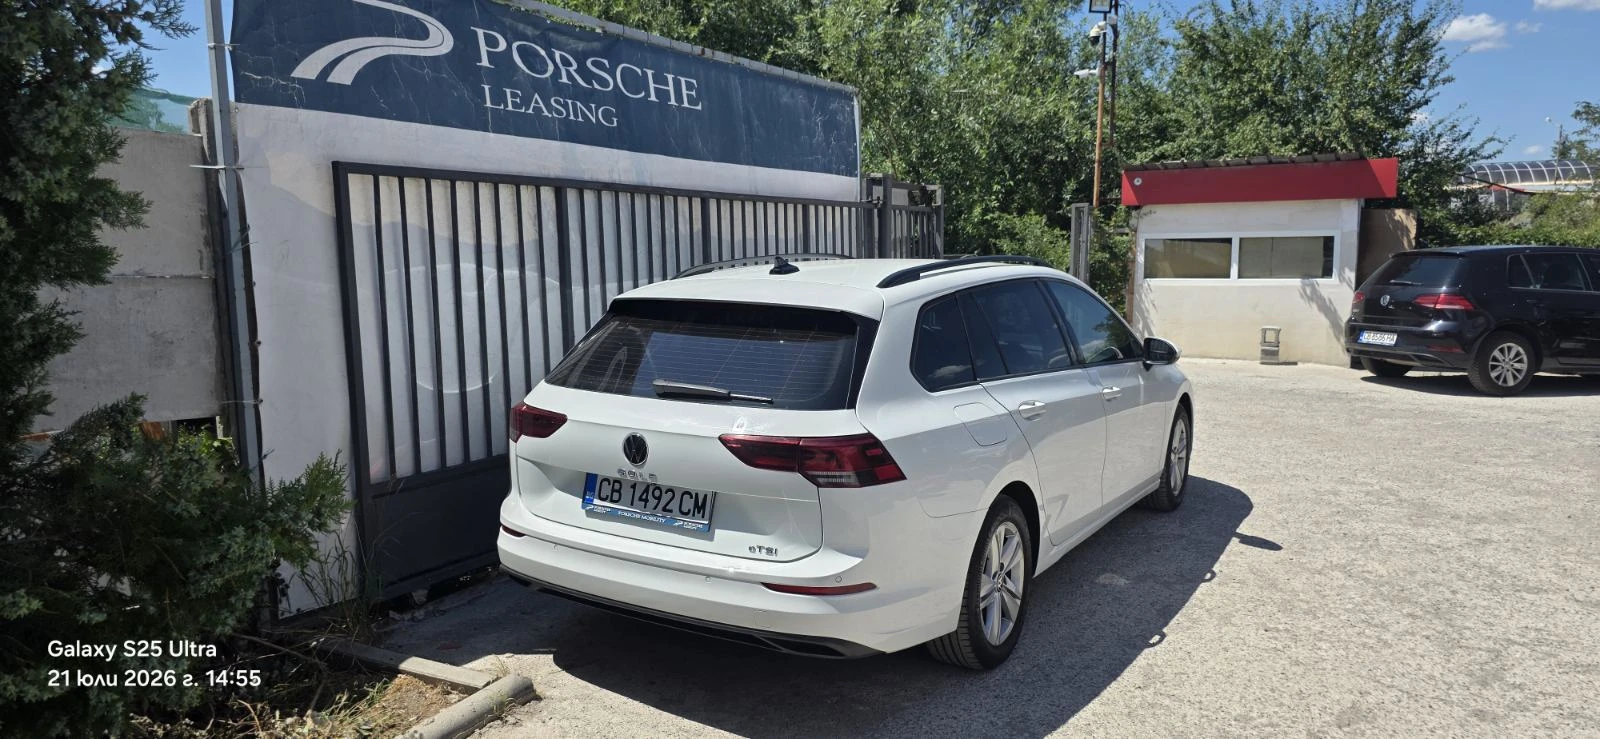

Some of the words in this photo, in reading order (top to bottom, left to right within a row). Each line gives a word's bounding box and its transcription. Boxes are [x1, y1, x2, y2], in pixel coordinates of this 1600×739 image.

[470, 26, 703, 111] PORSCHE
[480, 84, 619, 128] LEASING
[597, 477, 622, 504] CB
[629, 482, 676, 515] 1492
[678, 490, 708, 519] CM
